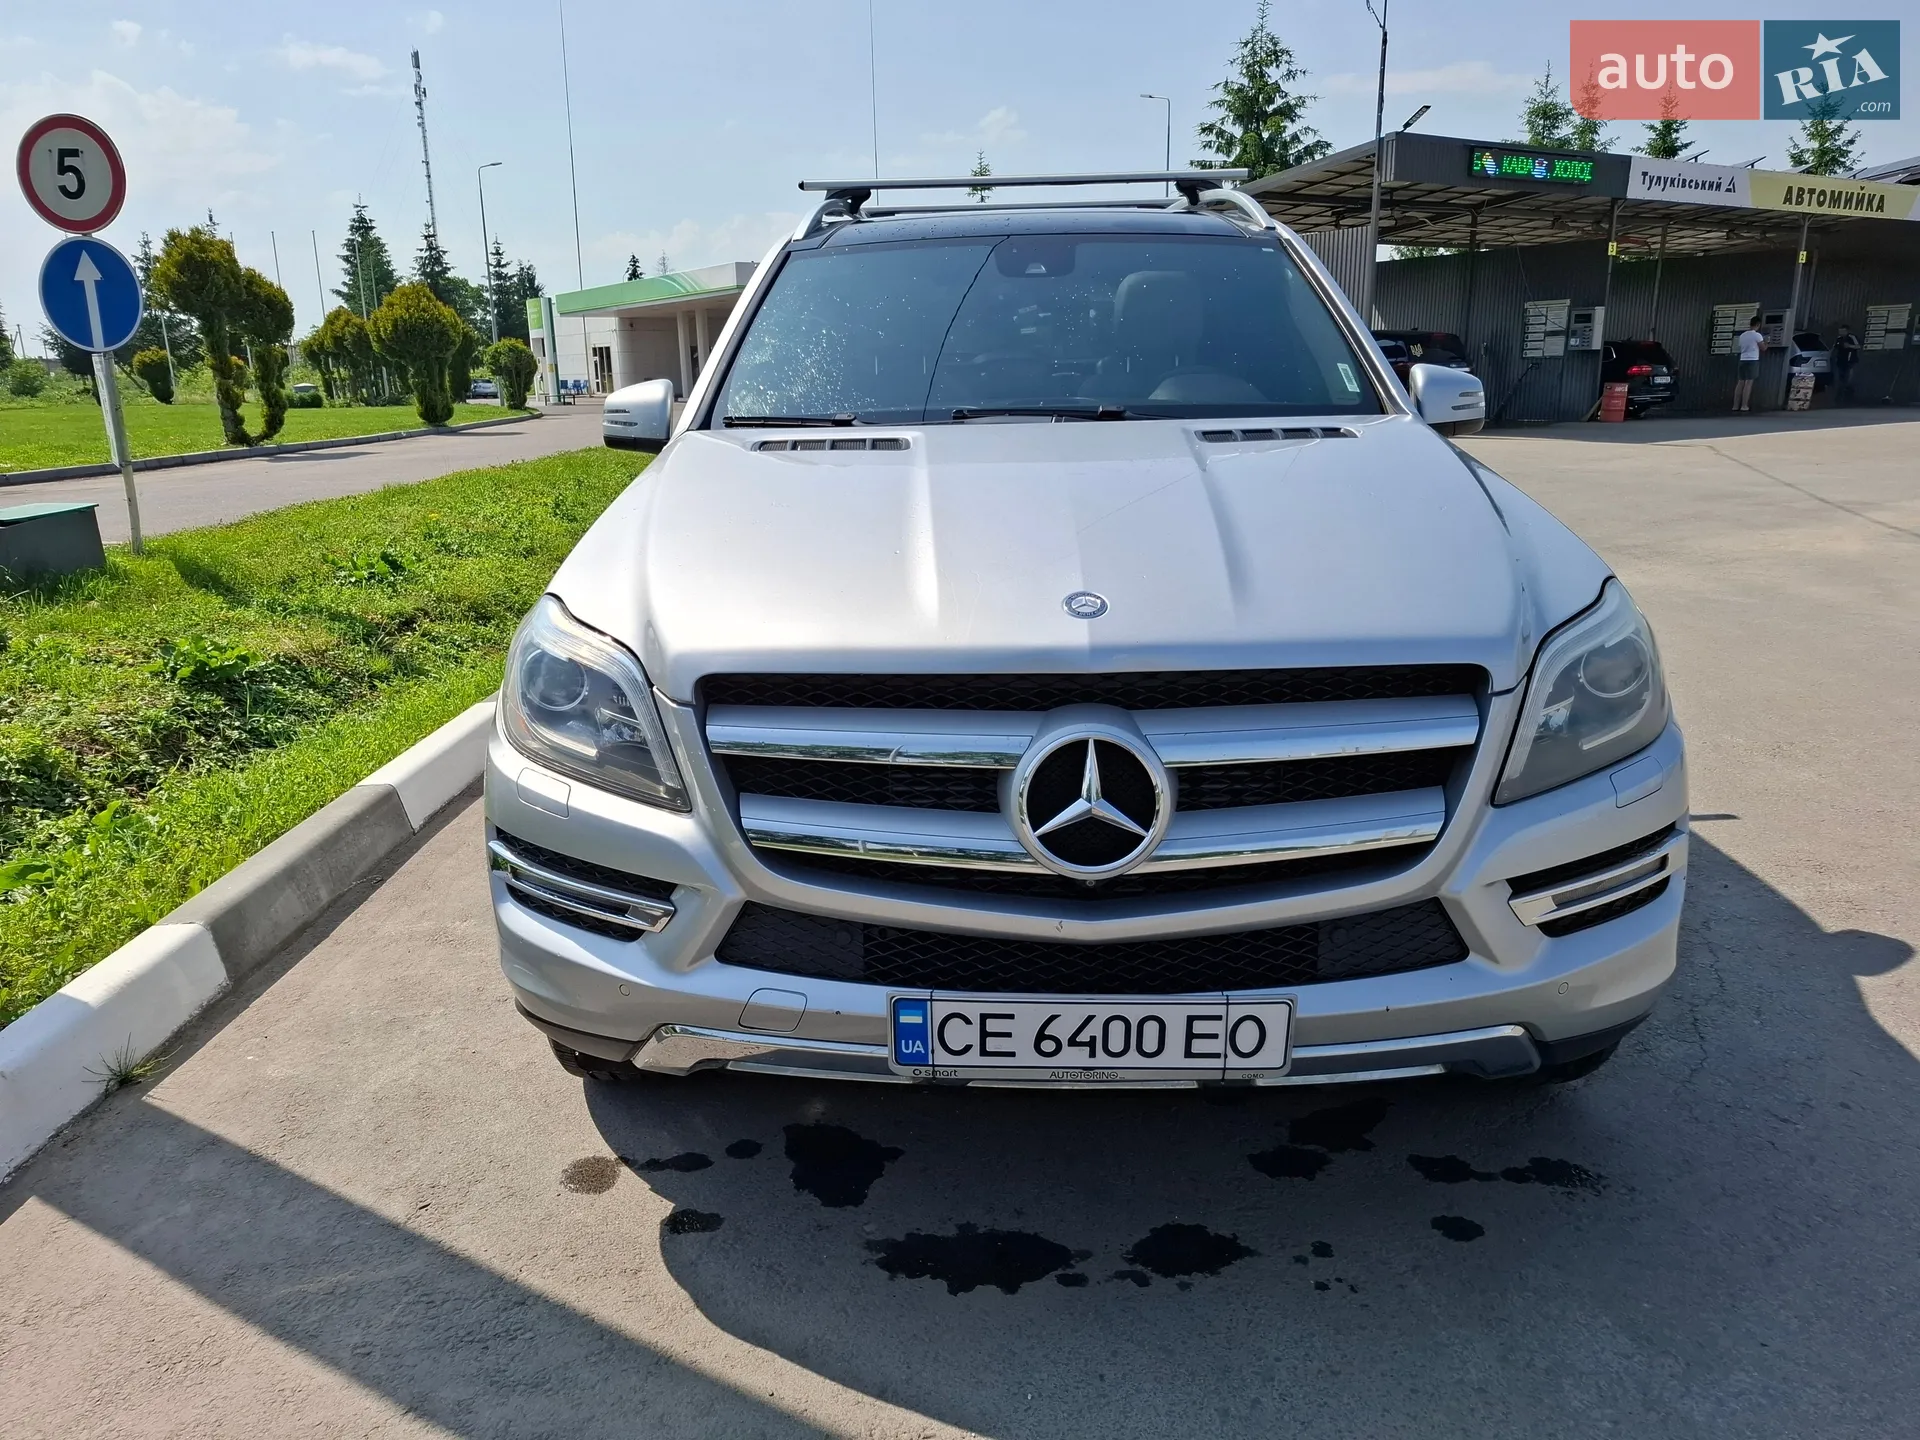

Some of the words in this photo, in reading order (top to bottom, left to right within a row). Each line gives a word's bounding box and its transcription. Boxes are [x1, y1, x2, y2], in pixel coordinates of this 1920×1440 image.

[57, 147, 86, 200] 5
[1641, 171, 1722, 192] Тулуківський
[1782, 185, 1885, 213] АВТОМИЙКА
[1610, 244, 1615, 253] 3
[1800, 253, 1805, 261] 2
[901, 1039, 925, 1054] UA
[936, 1012, 1016, 1058] CE
[1033, 1013, 1167, 1059] 6400
[1183, 1014, 1267, 1060] EO
[924, 1069, 958, 1077] smart
[1049, 1070, 1119, 1079] AUTOTORINO
